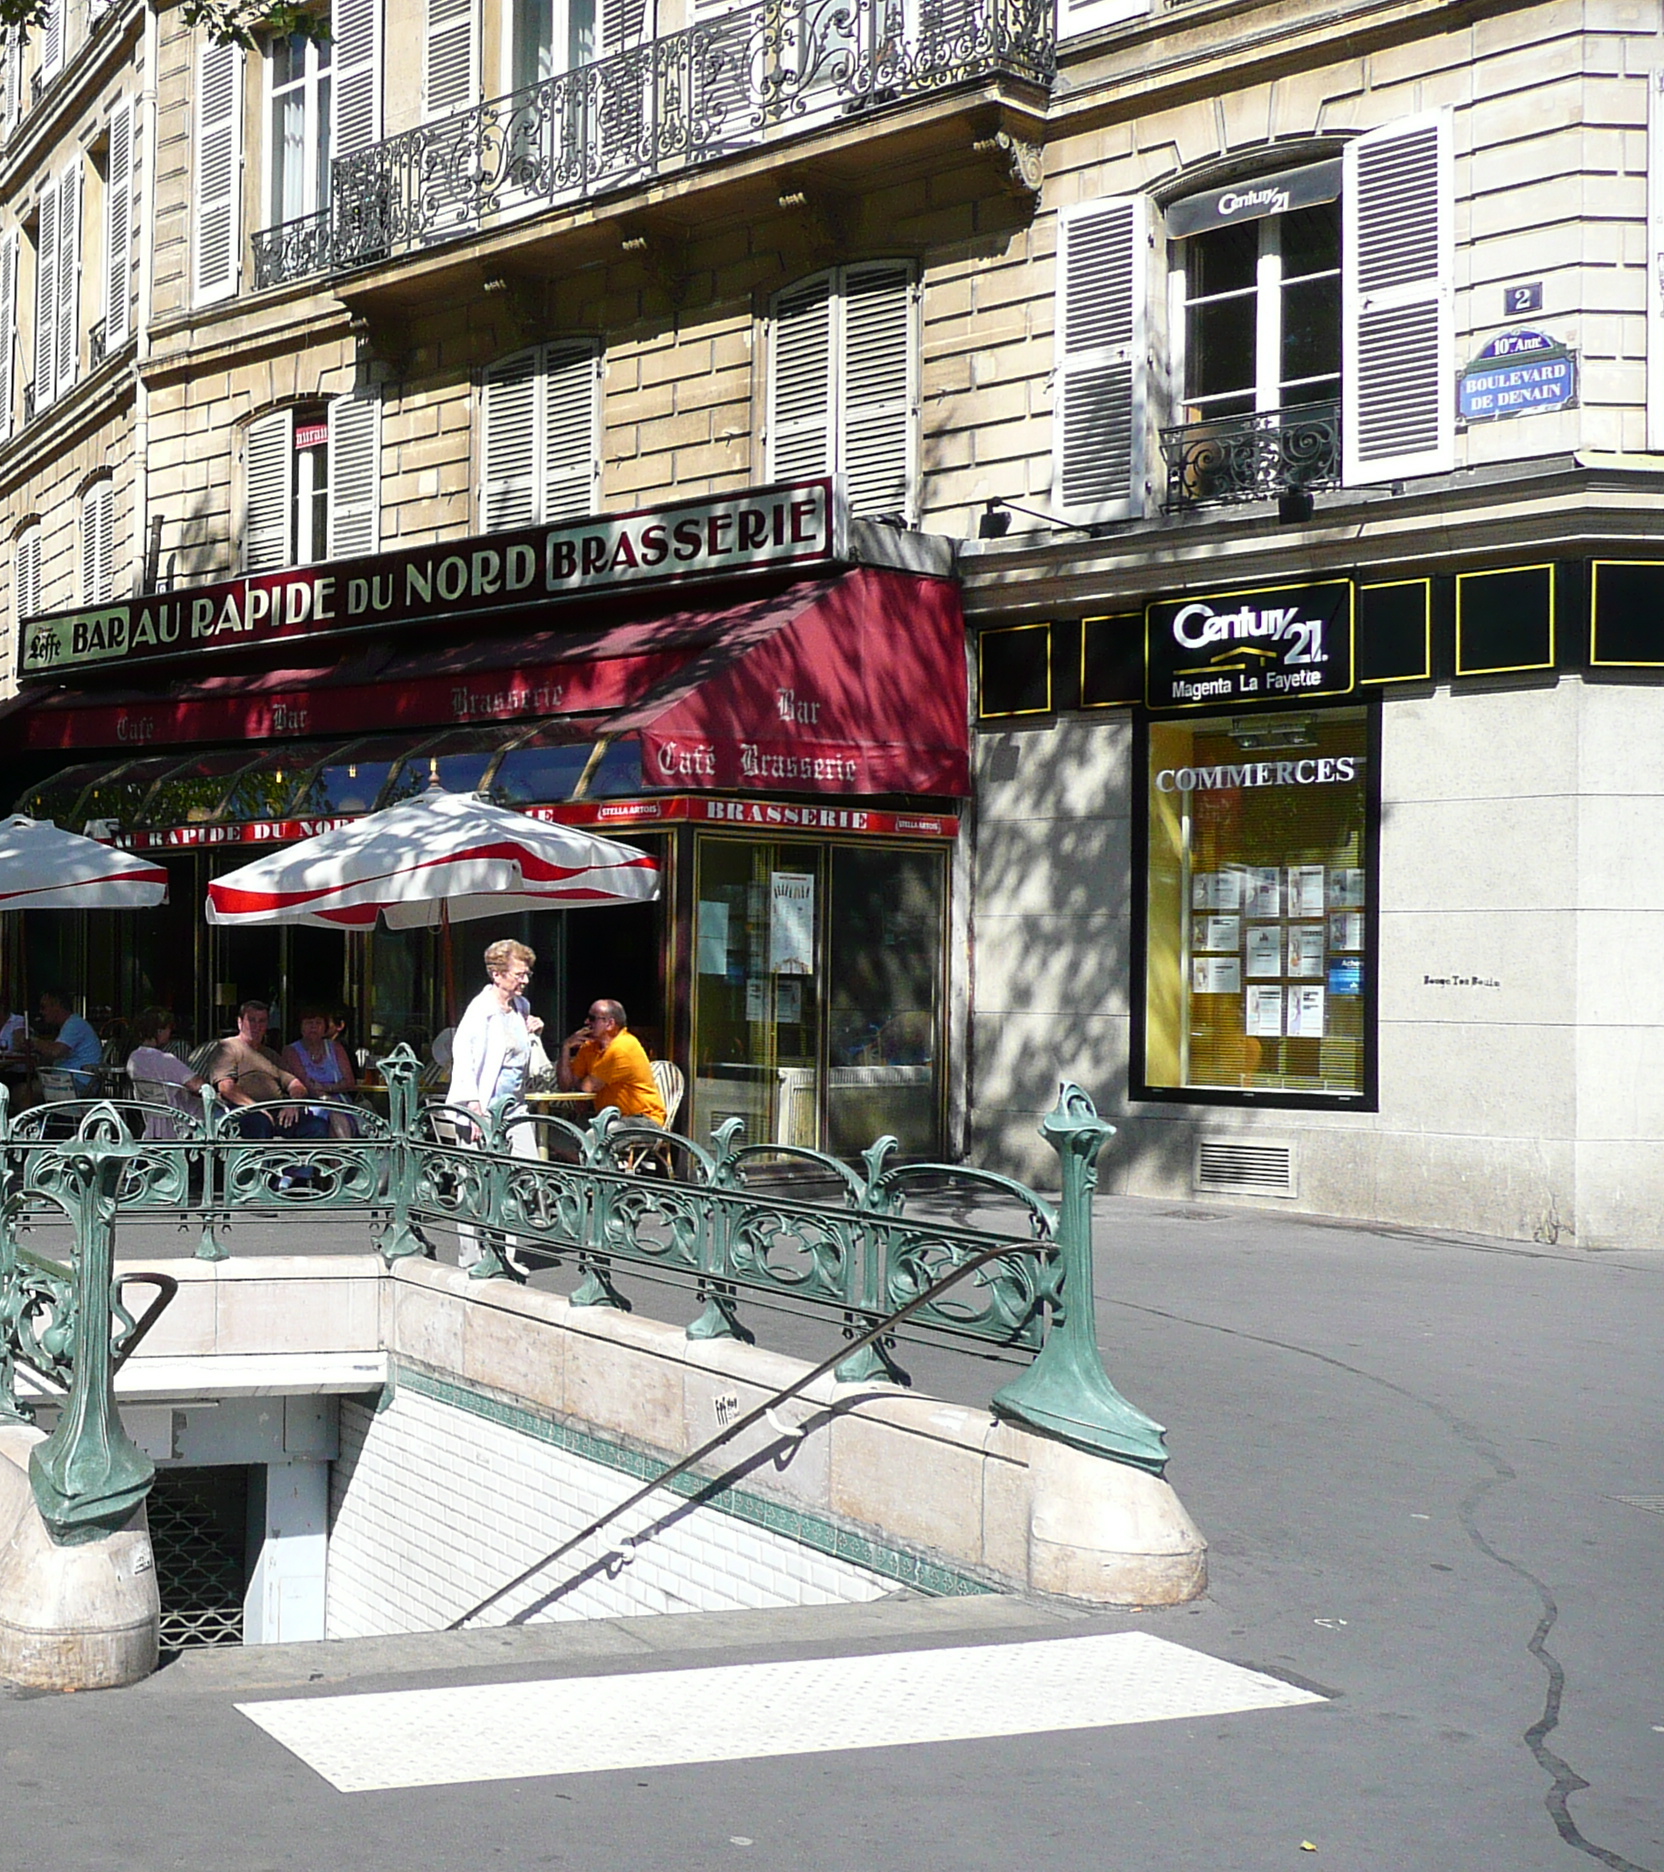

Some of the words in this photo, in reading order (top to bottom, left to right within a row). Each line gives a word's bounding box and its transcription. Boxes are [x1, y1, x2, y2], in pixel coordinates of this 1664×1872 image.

[1218, 187, 1279, 215] Century
[1270, 191, 1290, 214] 21
[1514, 288, 1531, 310] 2
[1465, 364, 1566, 393] BOULEVARD
[1471, 395, 1493, 411] DE
[1497, 383, 1561, 406] DENAIN
[72, 615, 125, 654] BAR
[132, 602, 180, 648] AU
[191, 575, 335, 638] RAPIDE
[348, 573, 393, 614] DU
[406, 544, 536, 606] NORD
[552, 499, 817, 580] BRASSERIE
[1173, 603, 1299, 648] Century
[28, 633, 61, 663] Leffe
[1172, 678, 1232, 700] Magenta
[1239, 674, 1259, 692] La
[1266, 669, 1321, 692] Fayette
[117, 715, 153, 741] Café
[273, 704, 308, 730] Bar
[451, 684, 563, 716] Brasserie
[777, 688, 820, 725] Bar
[657, 741, 717, 777] Café
[740, 743, 857, 782] Brasserie
[1155, 757, 1355, 792] COMMERCES
[602, 807, 628, 815] STELLA
[629, 805, 656, 814] ARTOIS
[707, 801, 868, 829] BRASSERIE
[148, 824, 241, 847] RAPIDE
[253, 822, 287, 840] DU
